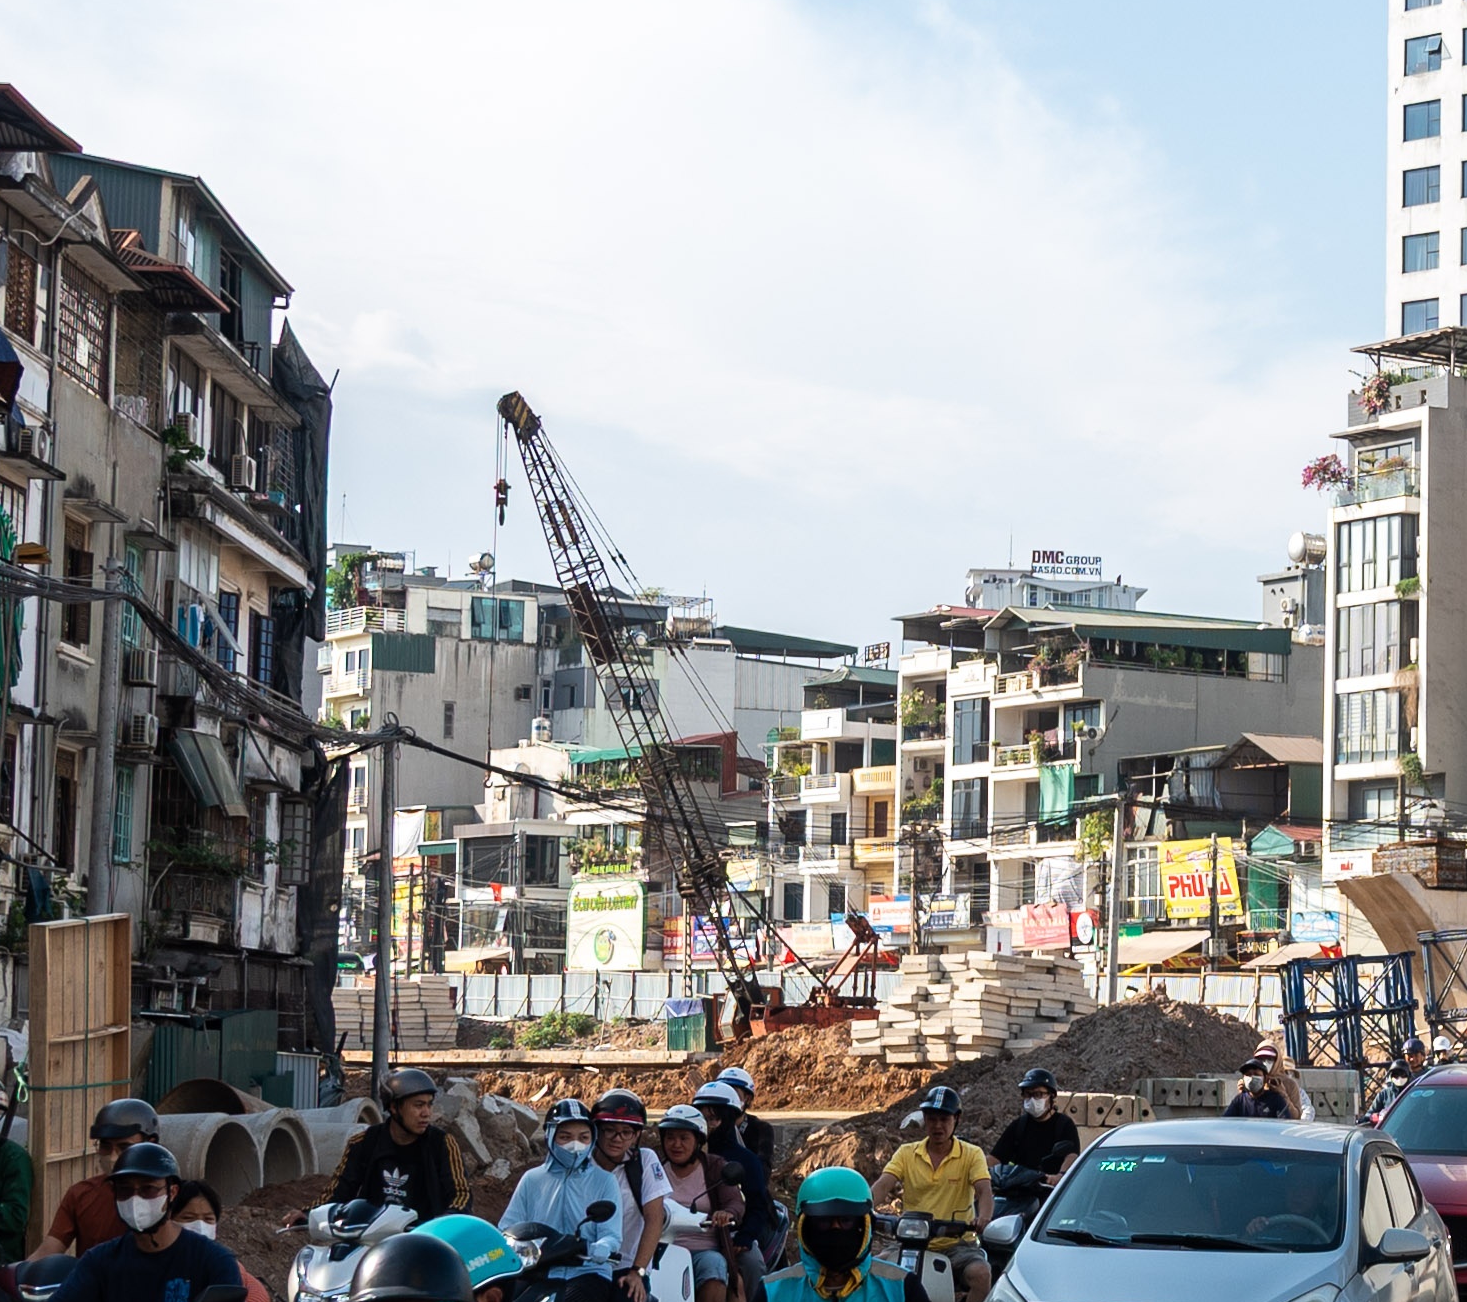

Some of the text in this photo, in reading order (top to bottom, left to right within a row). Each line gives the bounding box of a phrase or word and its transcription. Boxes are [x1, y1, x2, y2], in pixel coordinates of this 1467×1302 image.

[1032, 550, 1102, 566] DMC GROUP
[1168, 869, 1204, 898] PHÚ
[1100, 1161, 1137, 1172] TAXI
